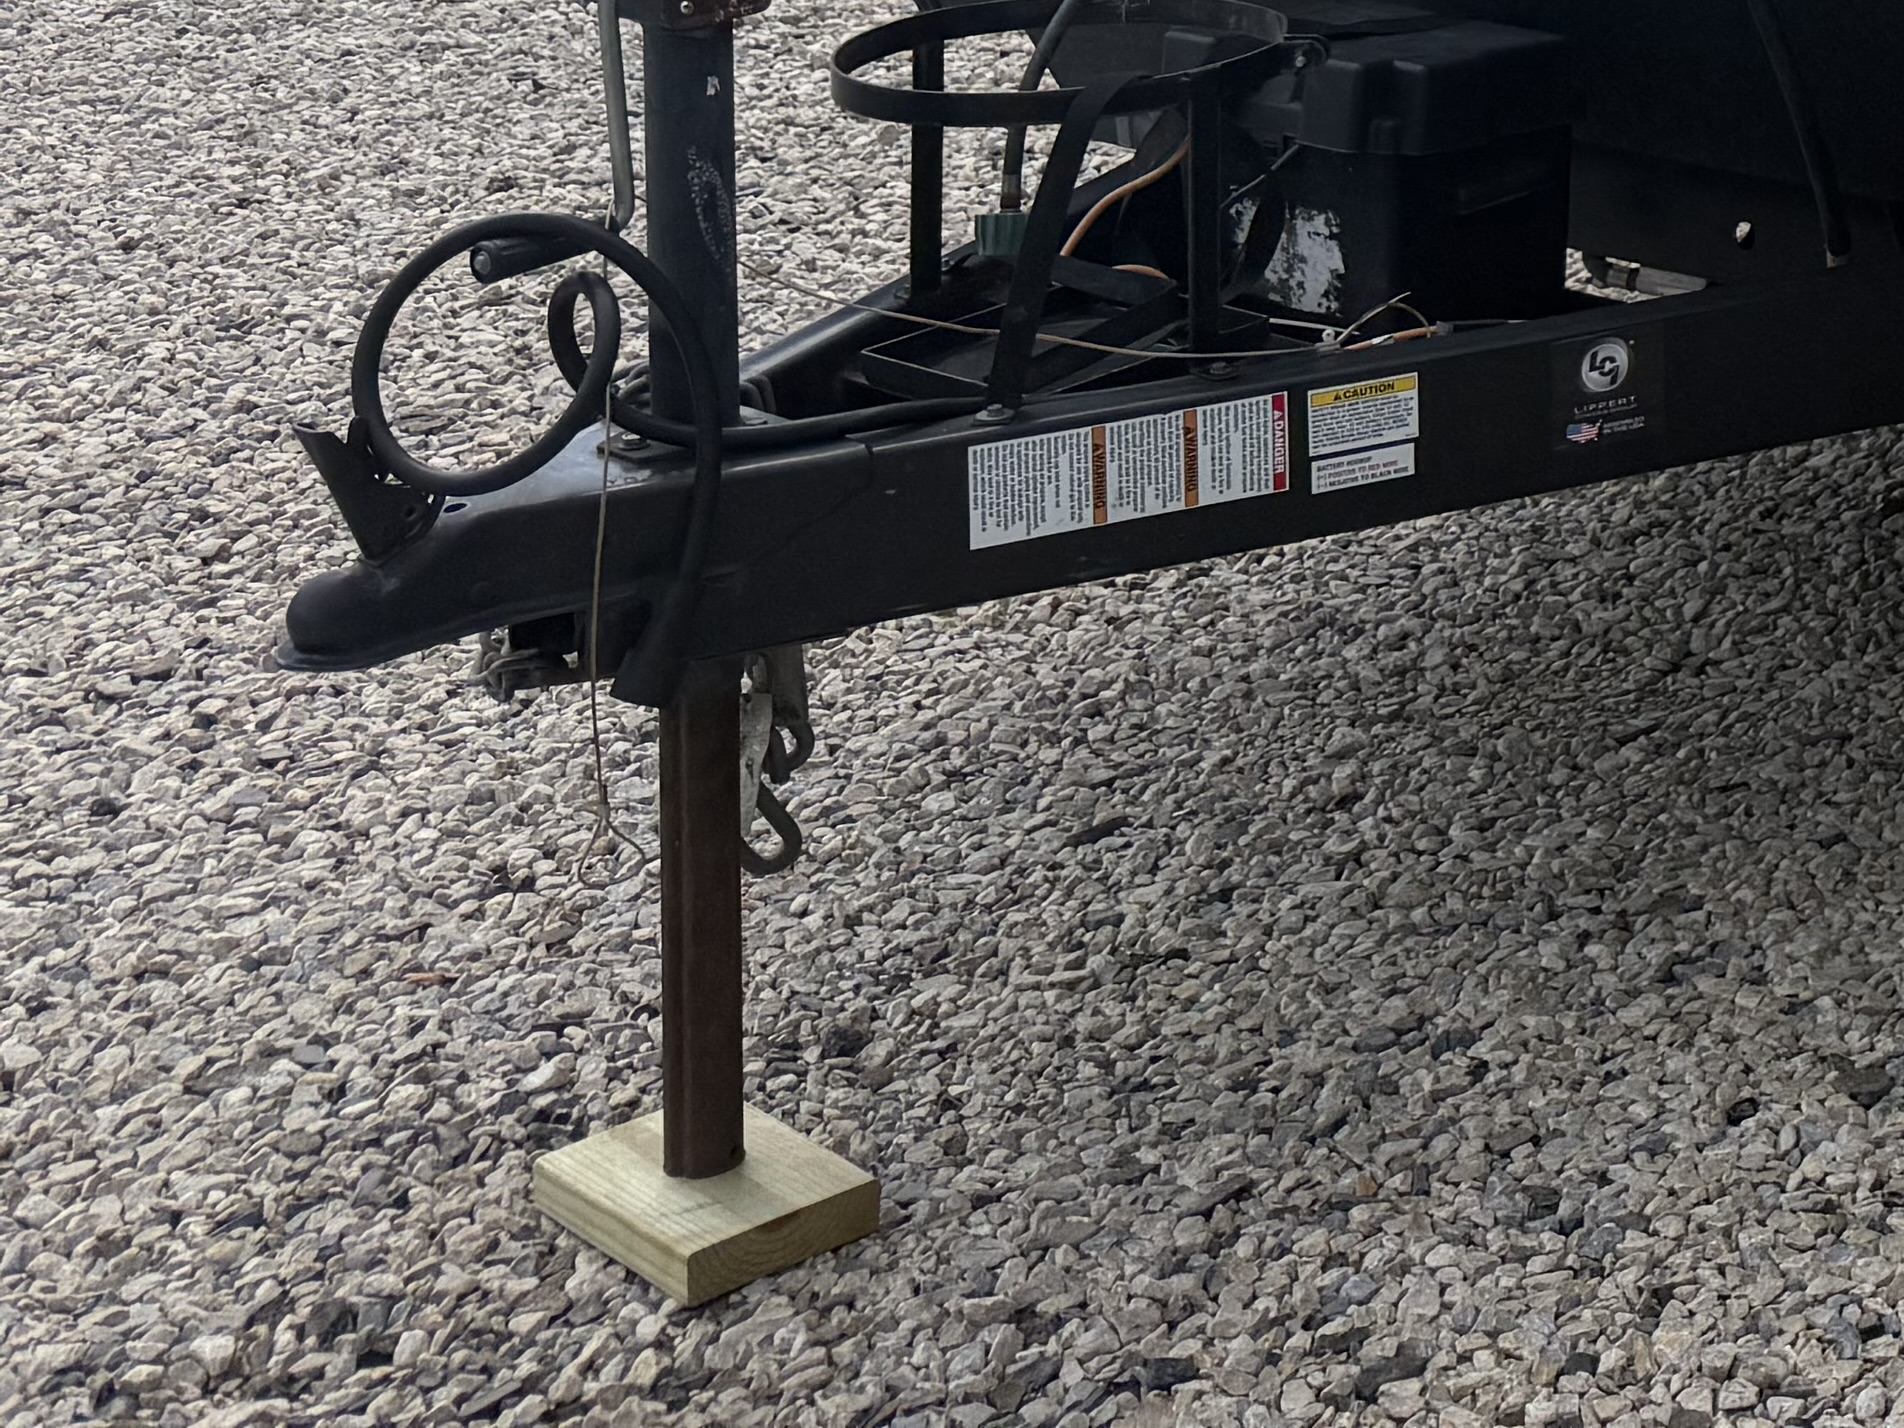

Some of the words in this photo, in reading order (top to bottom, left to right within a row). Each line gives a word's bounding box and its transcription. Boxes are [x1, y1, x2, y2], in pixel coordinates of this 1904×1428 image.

[1343, 382, 1395, 399] CAUTION
[1574, 396, 1637, 414] LIPPERT
[1185, 436, 1197, 492] WARNING
[1273, 422, 1285, 474] DANGER
[1093, 452, 1105, 509] WARNING
